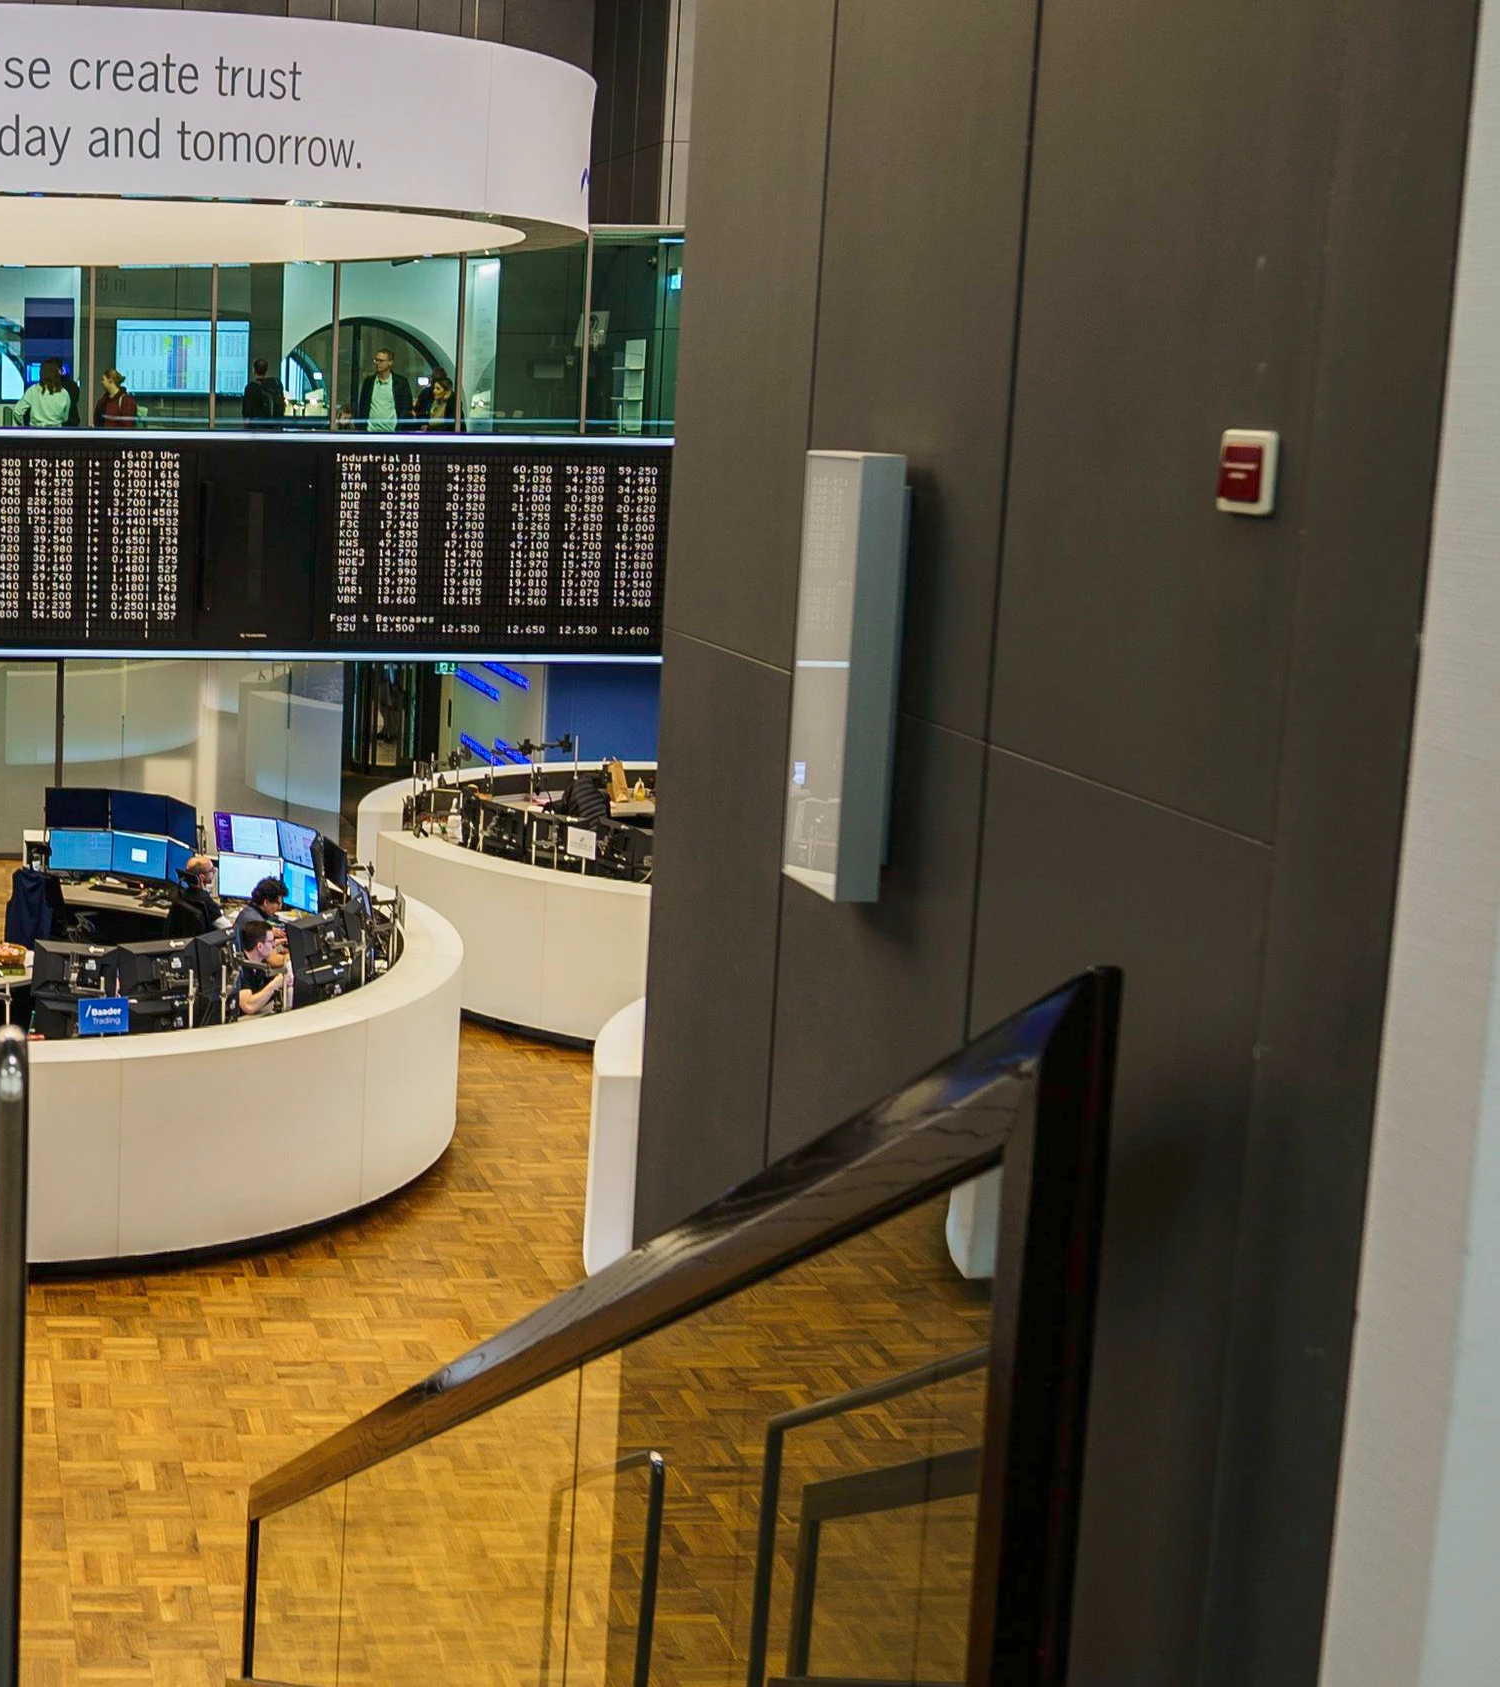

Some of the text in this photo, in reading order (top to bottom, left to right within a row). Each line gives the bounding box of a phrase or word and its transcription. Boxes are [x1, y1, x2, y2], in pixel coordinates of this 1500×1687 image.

[70, 53, 198, 94] create
[215, 56, 302, 101] trust
[89, 117, 160, 159] and
[177, 121, 361, 169] tomorrow.
[336, 453, 400, 462] Industrial
[29, 459, 74, 467] 170,140
[381, 464, 605, 474] 60,000 60,500 59,250
[35, 478, 73, 486] 46,570
[342, 473, 604, 484] TKA 4,926 5,036 4,925
[35, 488, 73, 496] 16,625
[618, 486, 657, 494] 34,460
[387, 492, 550, 502] 0,995 1,004
[27, 507, 73, 515] 504,000
[380, 501, 419, 509] 20,540
[446, 502, 485, 510] 20,520
[512, 503, 550, 511] 21,000
[617, 505, 655, 513] 20,620
[340, 510, 655, 522] DEZ 5,725 5,755 5,650 5,665
[446, 521, 484, 529] 17,900
[34, 535, 72, 543] 39,540
[386, 530, 418, 538] 6,595
[451, 531, 484, 539] 6,630
[570, 532, 601, 540] 6,515
[622, 533, 654, 541] 6,540
[445, 540, 483, 548] 47,100
[510, 541, 548, 549] 47,100
[563, 541, 601, 549] 46,700
[33, 554, 72, 562] 30,160
[339, 548, 364, 556] NCH2
[564, 551, 601, 559] 14,520
[616, 551, 653, 560] 14,620
[33, 563, 72, 571] 34,640
[339, 558, 600, 568] NOEJ 15,970 15,470
[562, 569, 600, 578] 17,900
[379, 577, 416, 585] 19,990
[614, 579, 651, 588] 19,540
[27, 592, 71, 600] 120,200
[338, 586, 651, 597] VAR1 14,000
[509, 597, 546, 605] 19,560
[330, 614, 356, 622] Food
[337, 624, 649, 635] SZU 12,500 12,530 12,650 12,600
